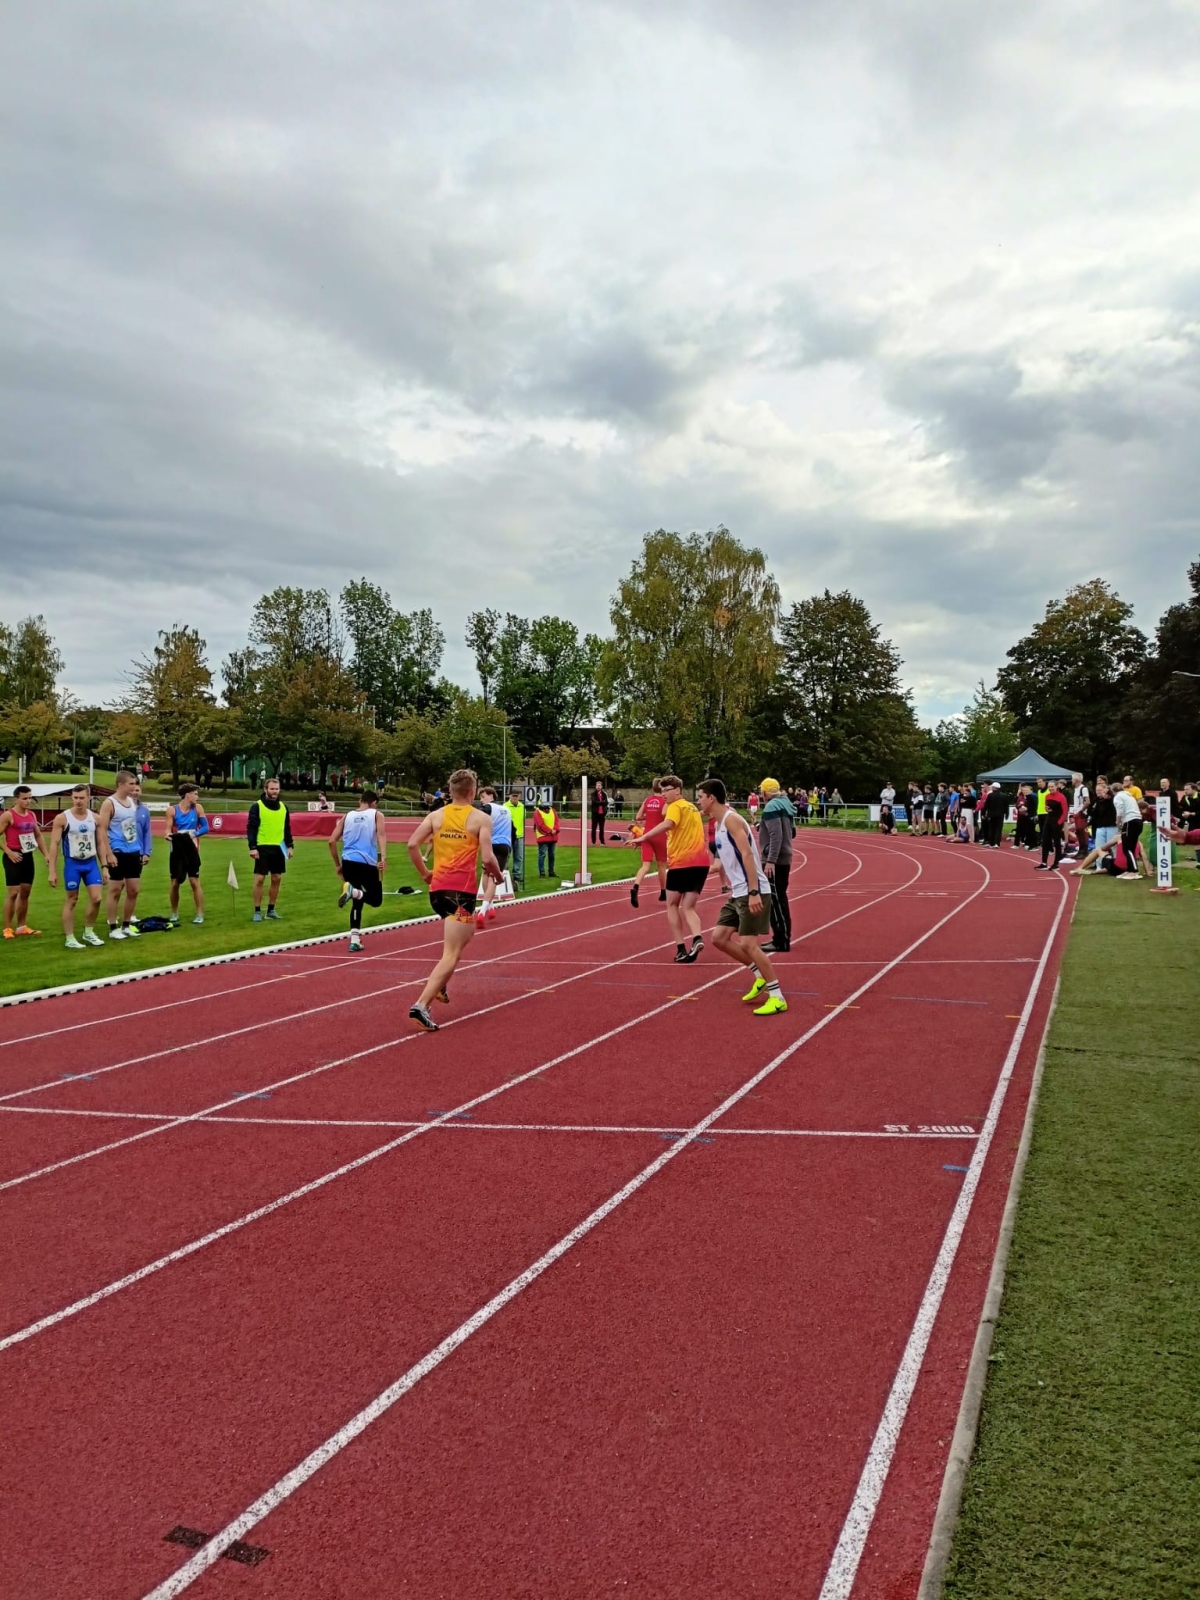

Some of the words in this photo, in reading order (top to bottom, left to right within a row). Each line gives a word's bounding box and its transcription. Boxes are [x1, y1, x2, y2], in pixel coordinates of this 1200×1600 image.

[79, 842, 92, 851] 24
[1159, 807, 1169, 881] FINISH
[883, 1124, 910, 1133] ST
[917, 1125, 976, 1134] 2000
